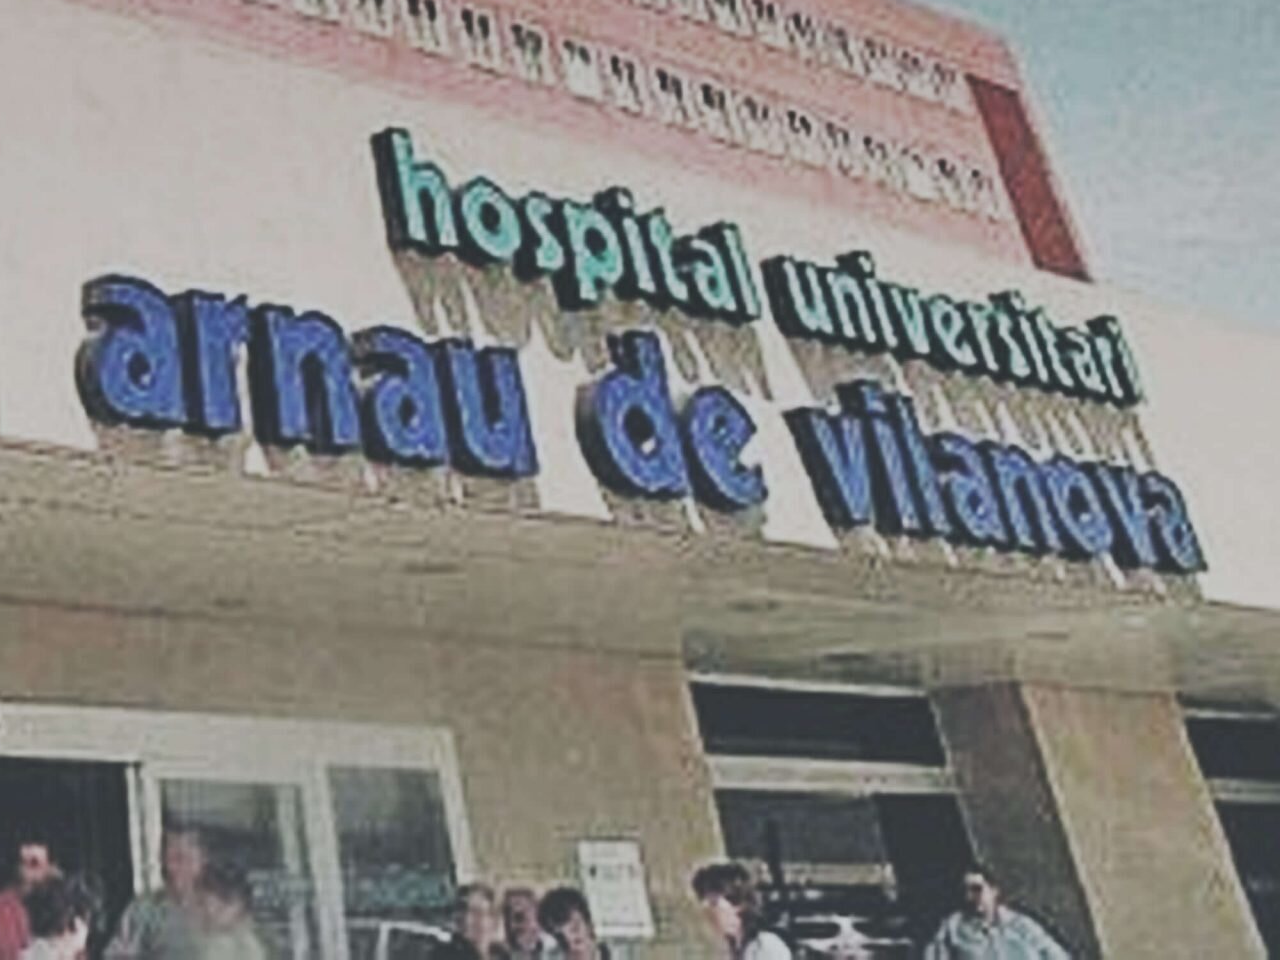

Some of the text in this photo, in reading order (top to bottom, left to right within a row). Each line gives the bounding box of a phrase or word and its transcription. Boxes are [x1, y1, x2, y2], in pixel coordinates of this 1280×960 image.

[374, 127, 1145, 407] hospital universitari
[77, 274, 1207, 573] arnau de vilanova
